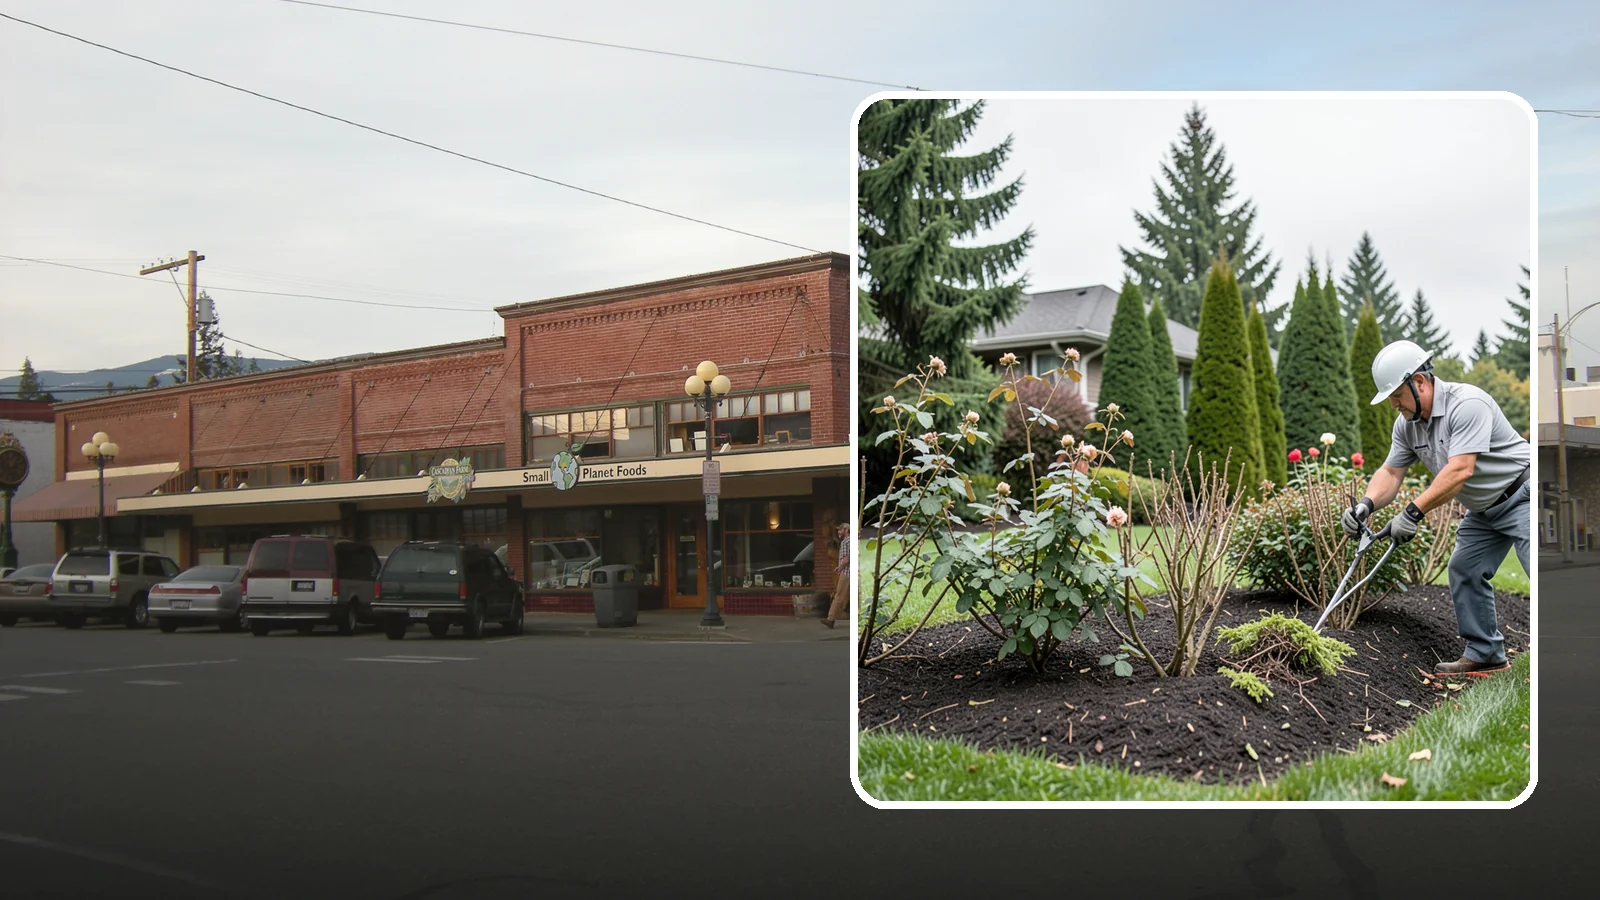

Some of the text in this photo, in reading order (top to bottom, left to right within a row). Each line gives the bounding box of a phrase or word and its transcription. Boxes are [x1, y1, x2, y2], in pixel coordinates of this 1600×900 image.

[523, 464, 647, 482] Small Planet Foods
